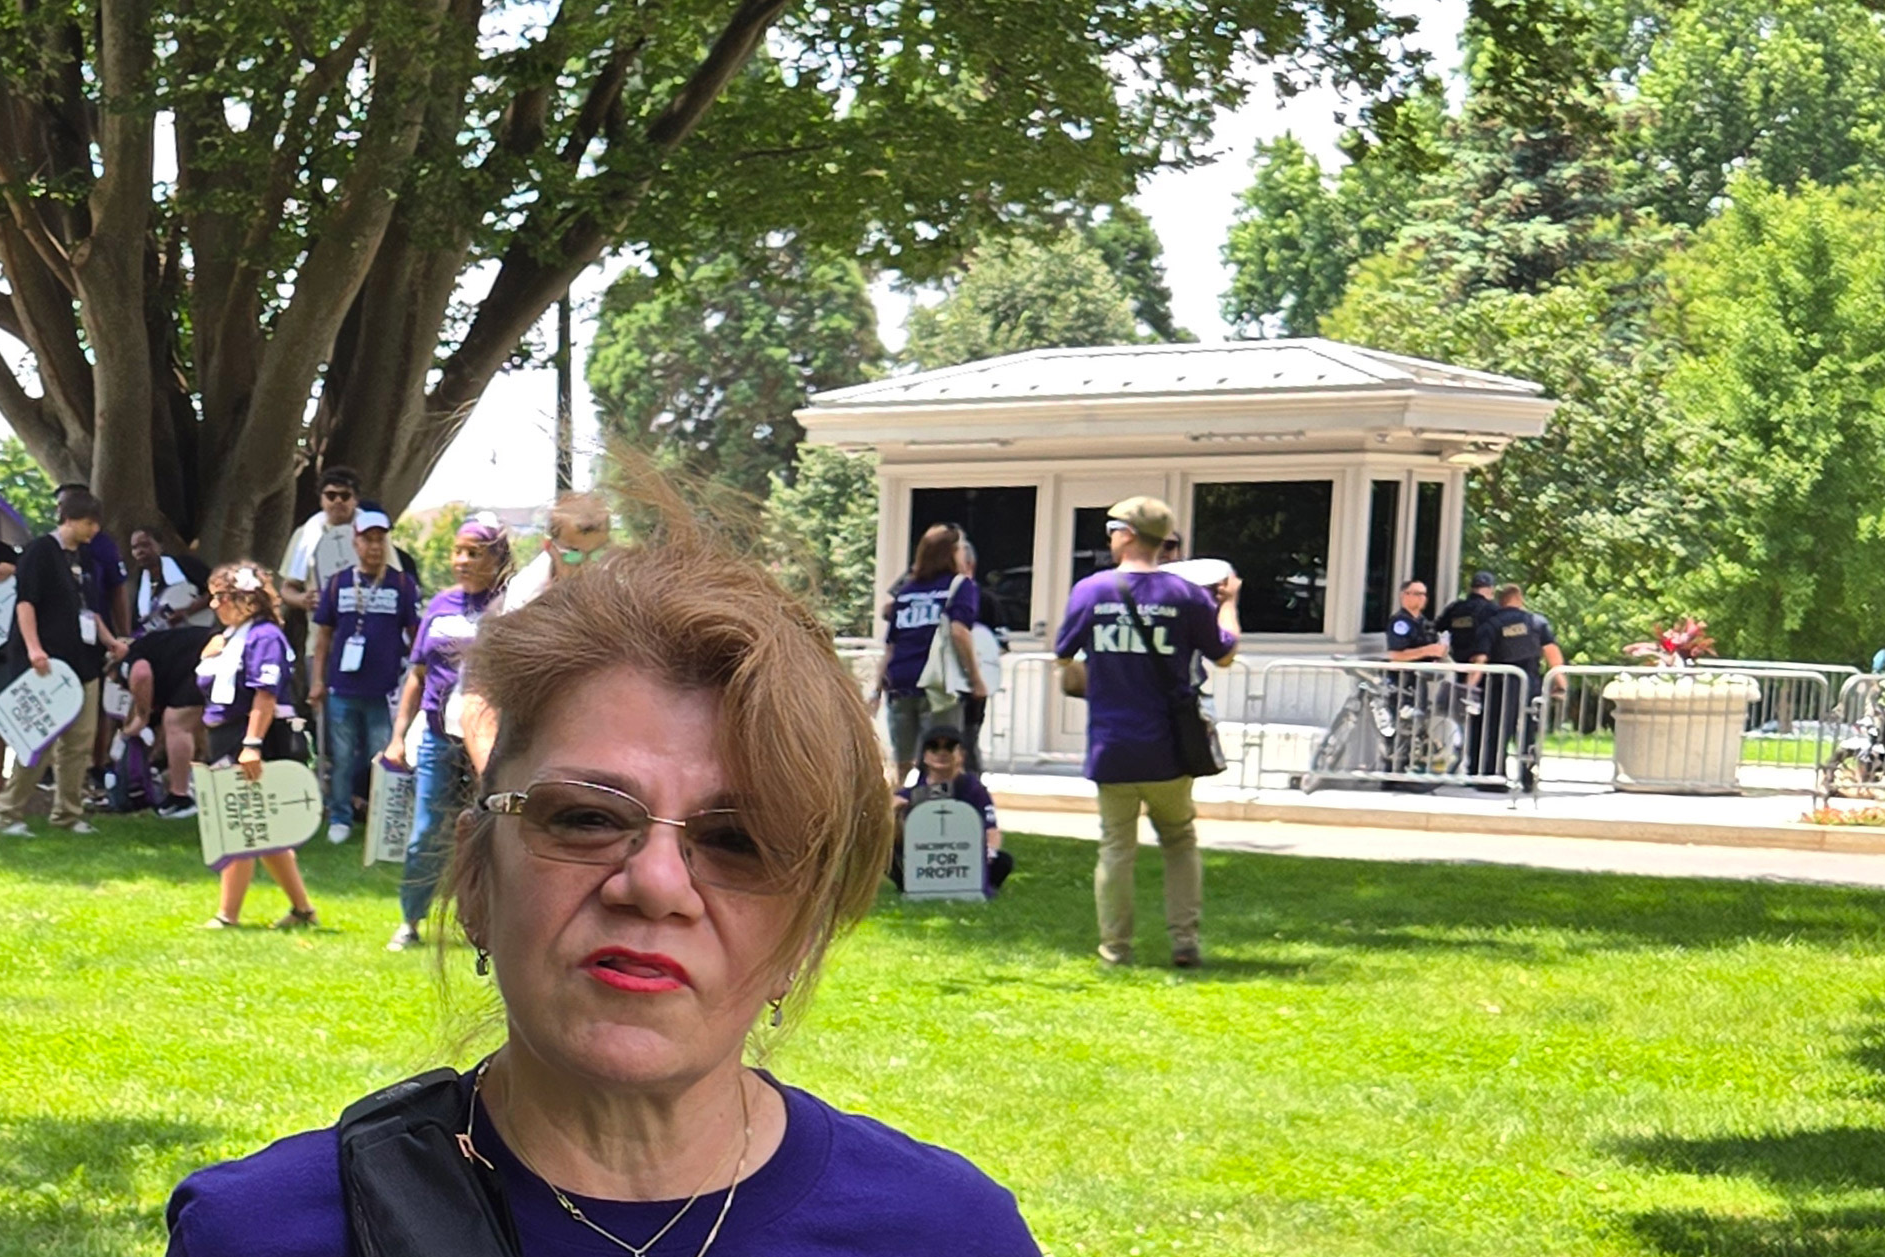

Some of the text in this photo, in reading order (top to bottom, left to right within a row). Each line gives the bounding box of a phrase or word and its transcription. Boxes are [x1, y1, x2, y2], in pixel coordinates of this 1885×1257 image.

[1094, 624, 1176, 655] KILL
[224, 792, 241, 831] CUTS
[251, 781, 270, 843] EATH BY
[916, 865, 970, 880] PROFIT
[926, 853, 959, 866] FOR
